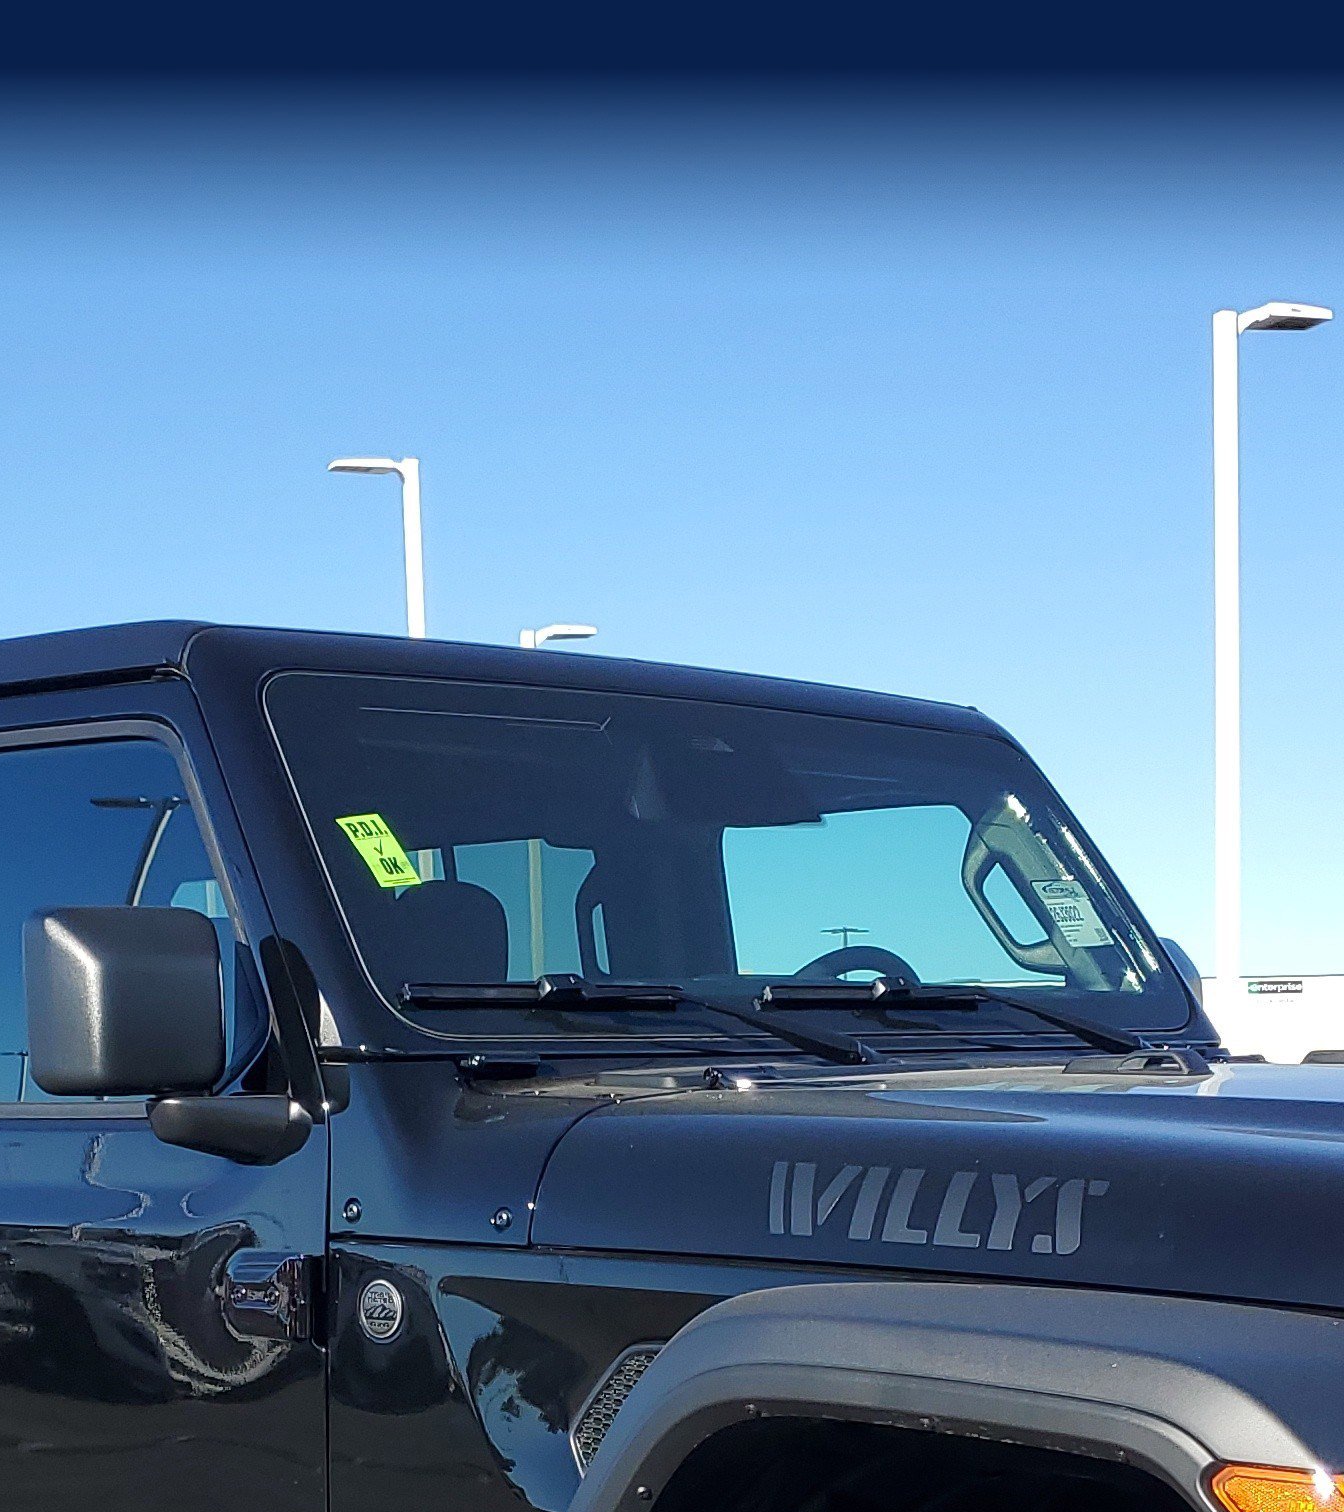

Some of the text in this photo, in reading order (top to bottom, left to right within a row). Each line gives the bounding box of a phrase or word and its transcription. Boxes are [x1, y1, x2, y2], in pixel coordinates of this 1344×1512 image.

[345, 819, 389, 839] P.D.I.
[378, 856, 405, 875] OK
[1248, 982, 1303, 993] enterprise
[769, 1160, 1111, 1256] WILLYS
